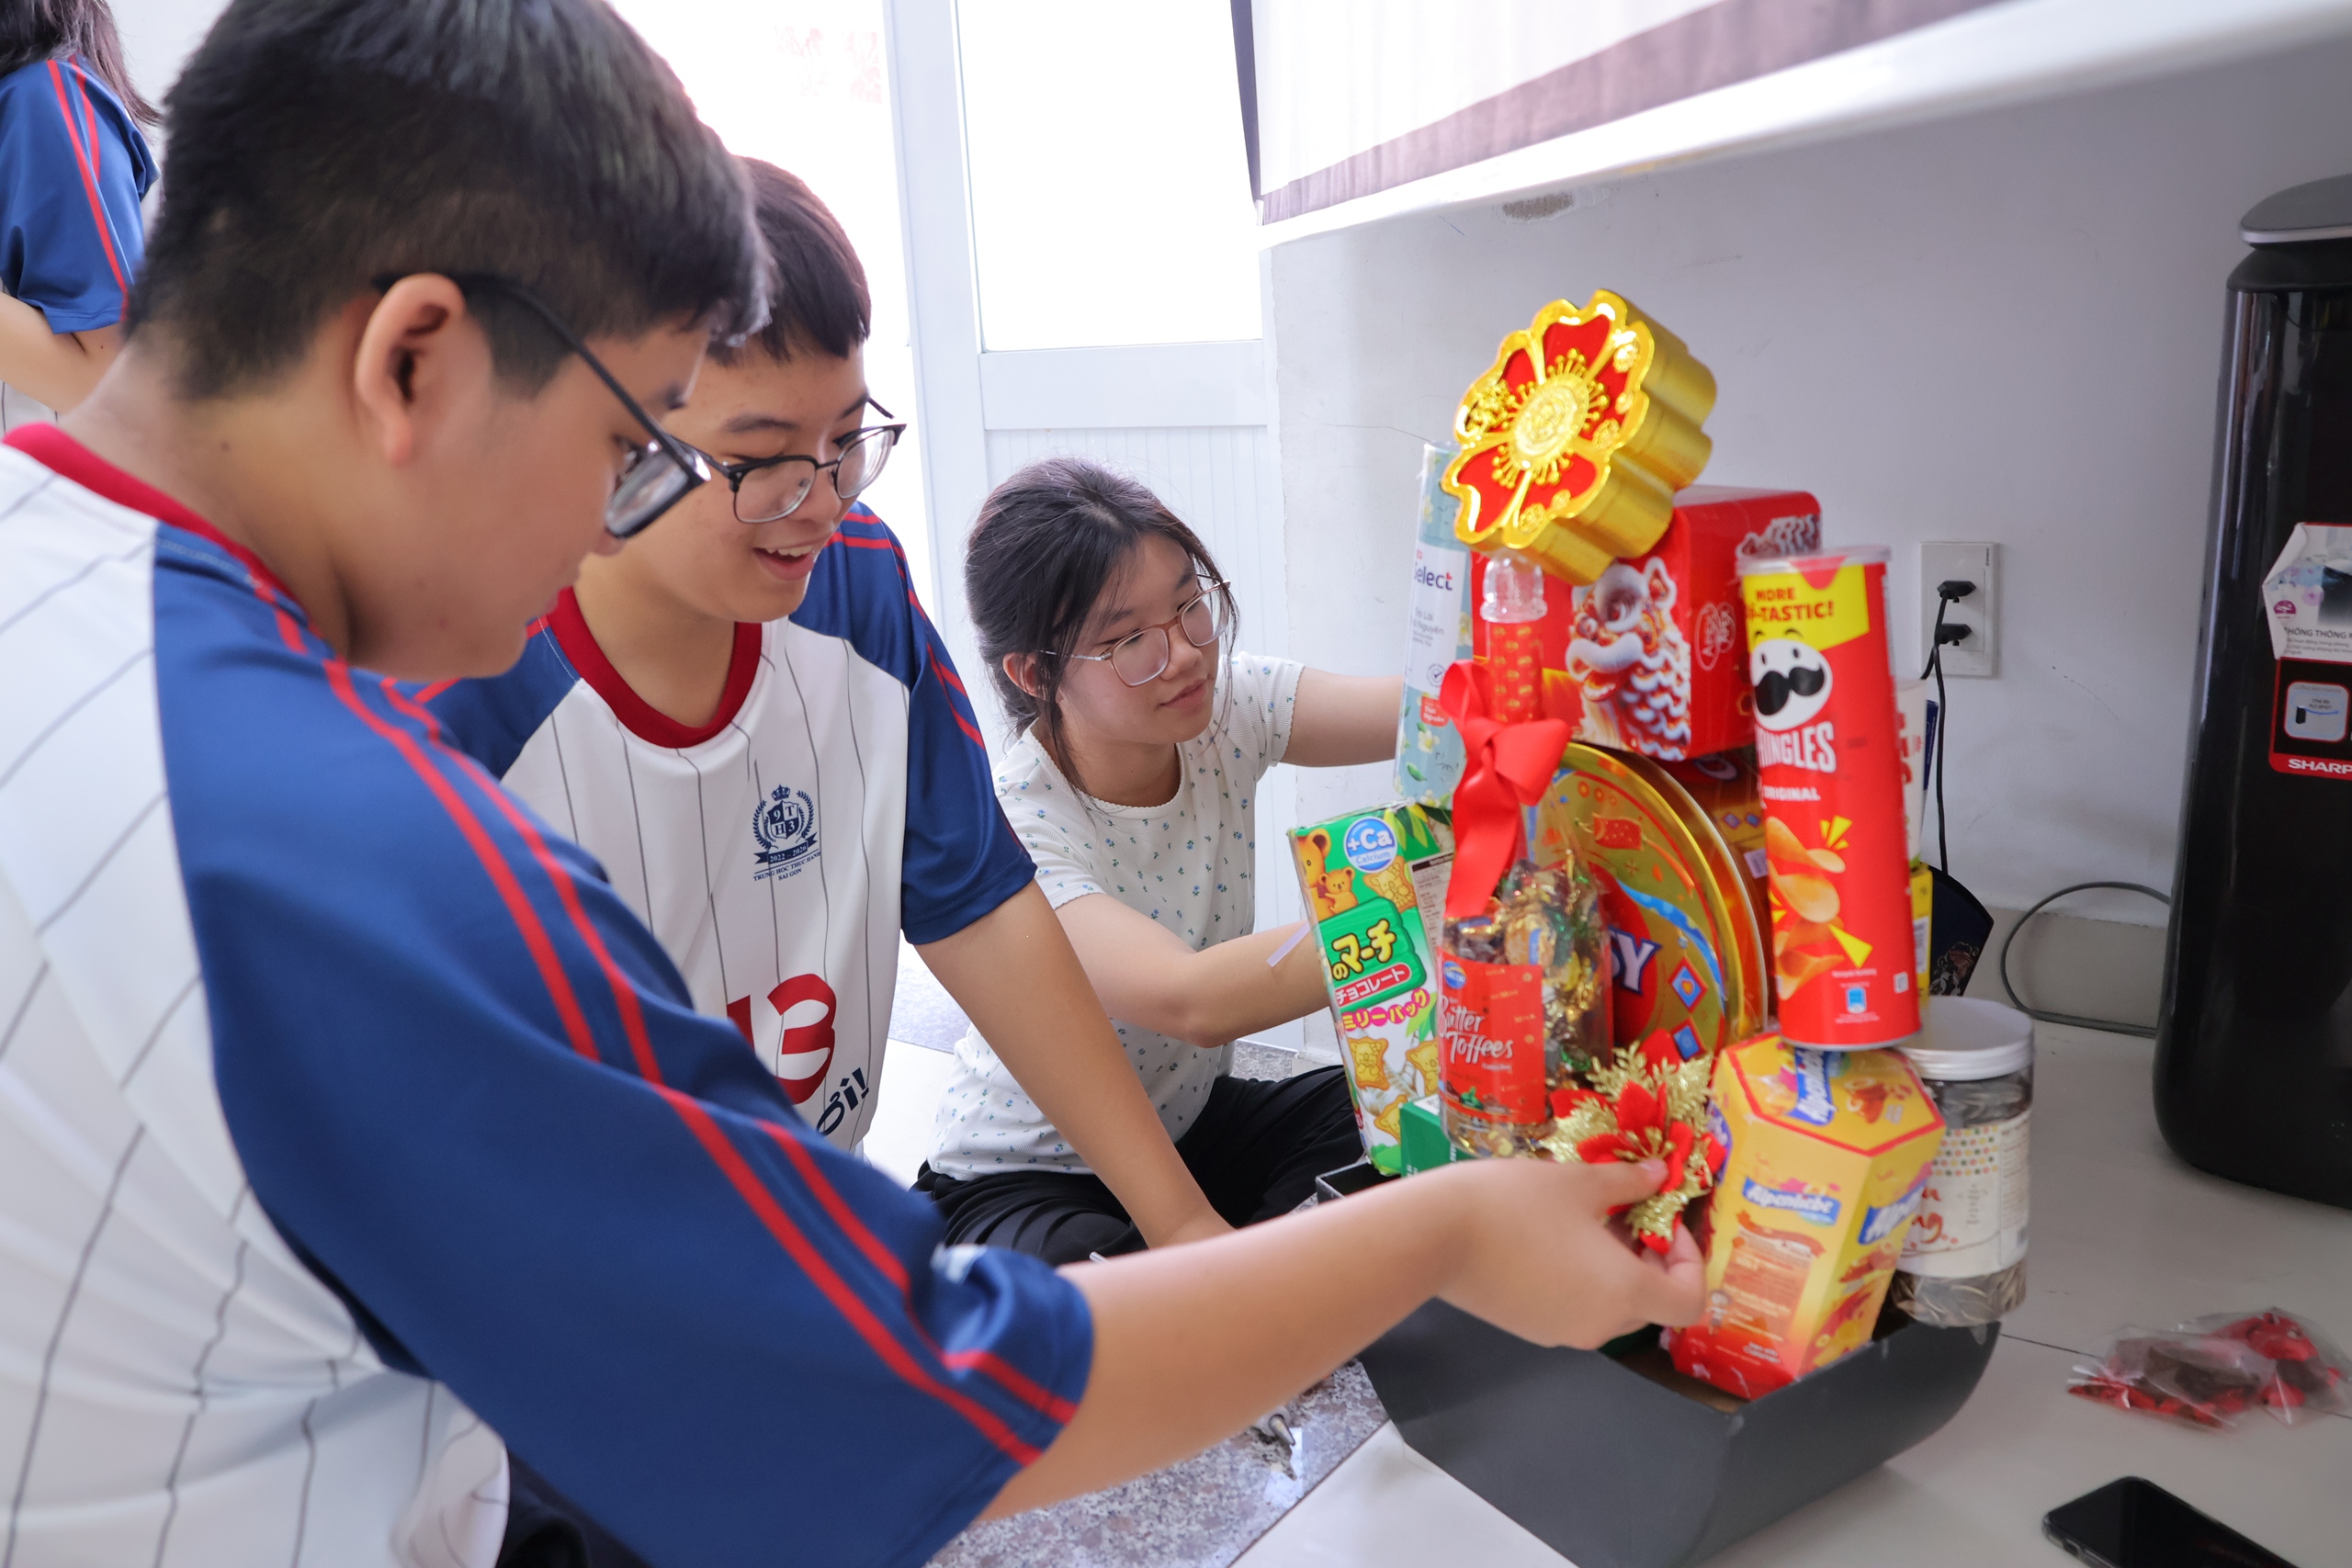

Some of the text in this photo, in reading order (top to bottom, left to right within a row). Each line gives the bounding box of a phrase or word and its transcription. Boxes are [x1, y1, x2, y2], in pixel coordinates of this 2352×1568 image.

[2288, 758, 2352, 774] SHARP
[769, 853, 786, 863] 2022
[792, 844, 808, 856] 2026
[1355, 851, 1391, 864] Calcium
[1335, 968, 1406, 1007] チョコレート
[1445, 1030, 1514, 1064] Toffees
